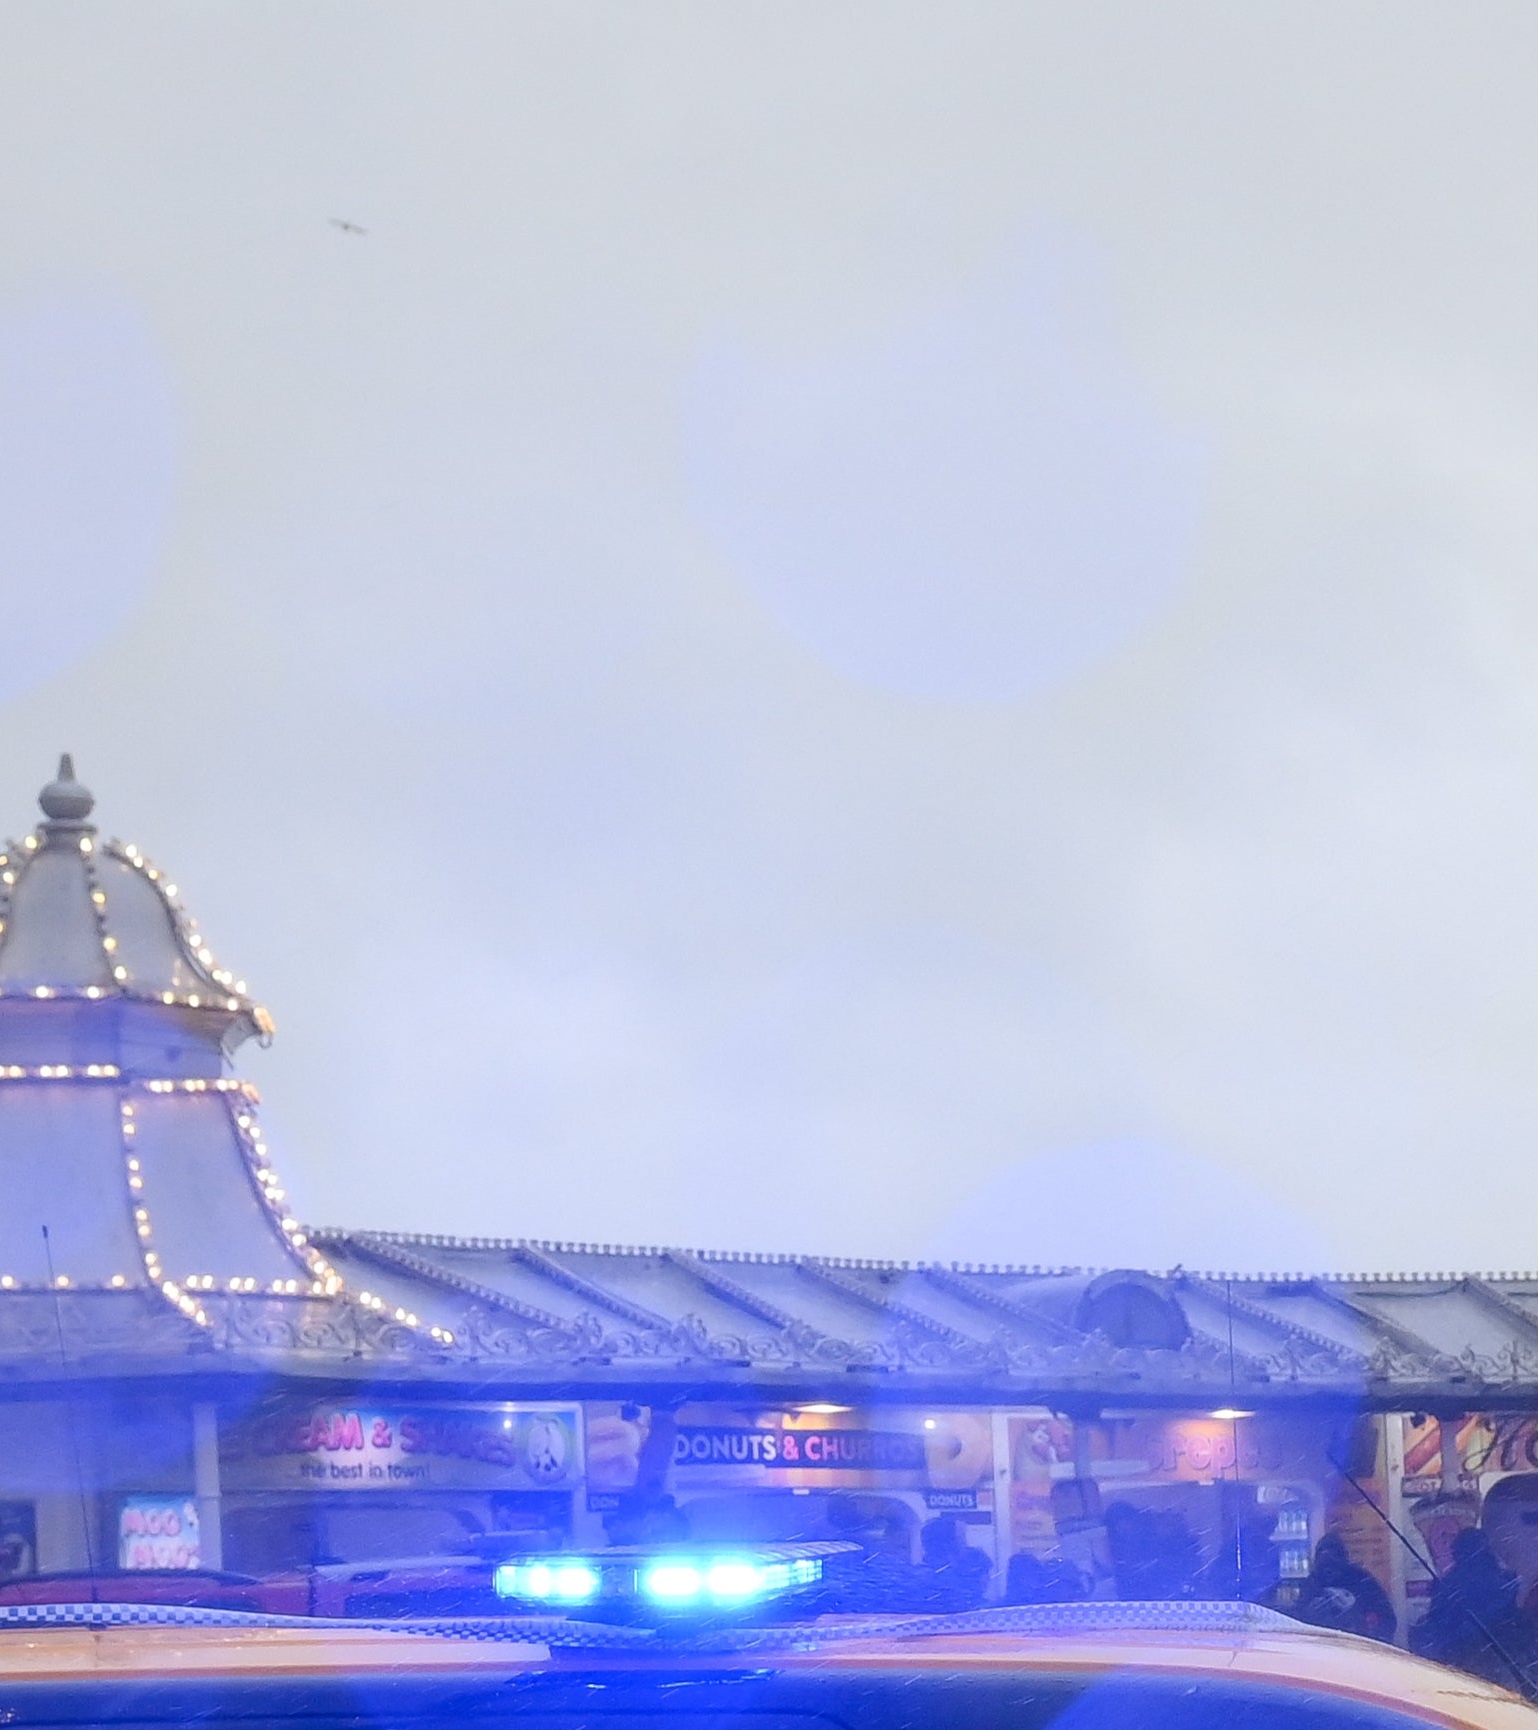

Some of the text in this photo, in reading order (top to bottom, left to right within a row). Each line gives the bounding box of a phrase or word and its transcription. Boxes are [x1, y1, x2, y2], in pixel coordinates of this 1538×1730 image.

[371, 1416, 393, 1449] &
[675, 1433, 920, 1463] DONUTS & CHURROS
[330, 1461, 363, 1479] best
[368, 1462, 384, 1479] in
[930, 1494, 974, 1508] DONUTS
